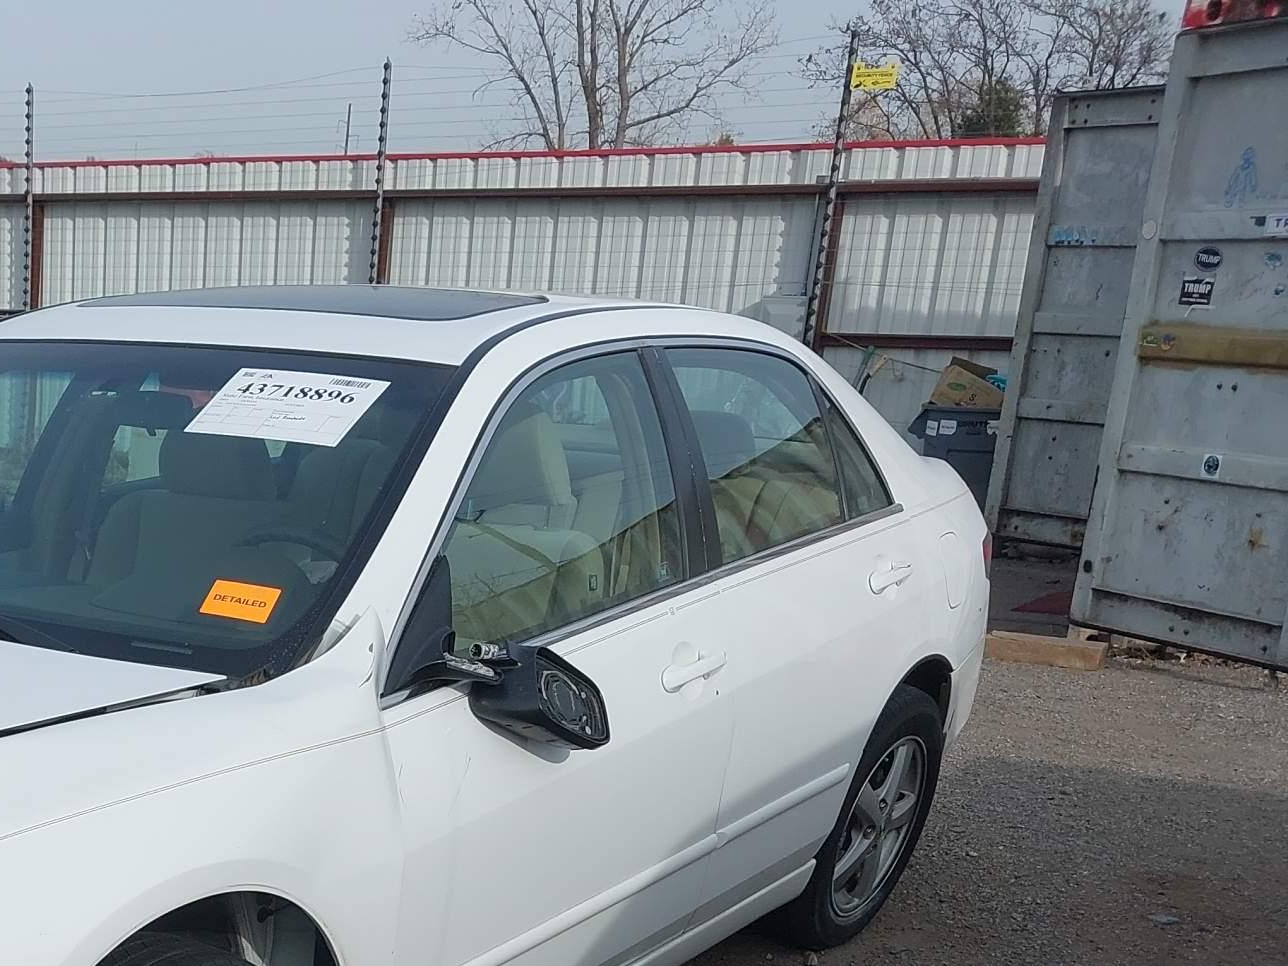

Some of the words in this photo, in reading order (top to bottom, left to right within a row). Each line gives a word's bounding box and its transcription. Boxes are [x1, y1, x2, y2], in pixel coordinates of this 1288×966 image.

[1198, 254, 1221, 264] TRUMP
[1184, 283, 1211, 294] TRUMP
[237, 382, 361, 404] 43718896
[213, 593, 267, 608] DETAILED
